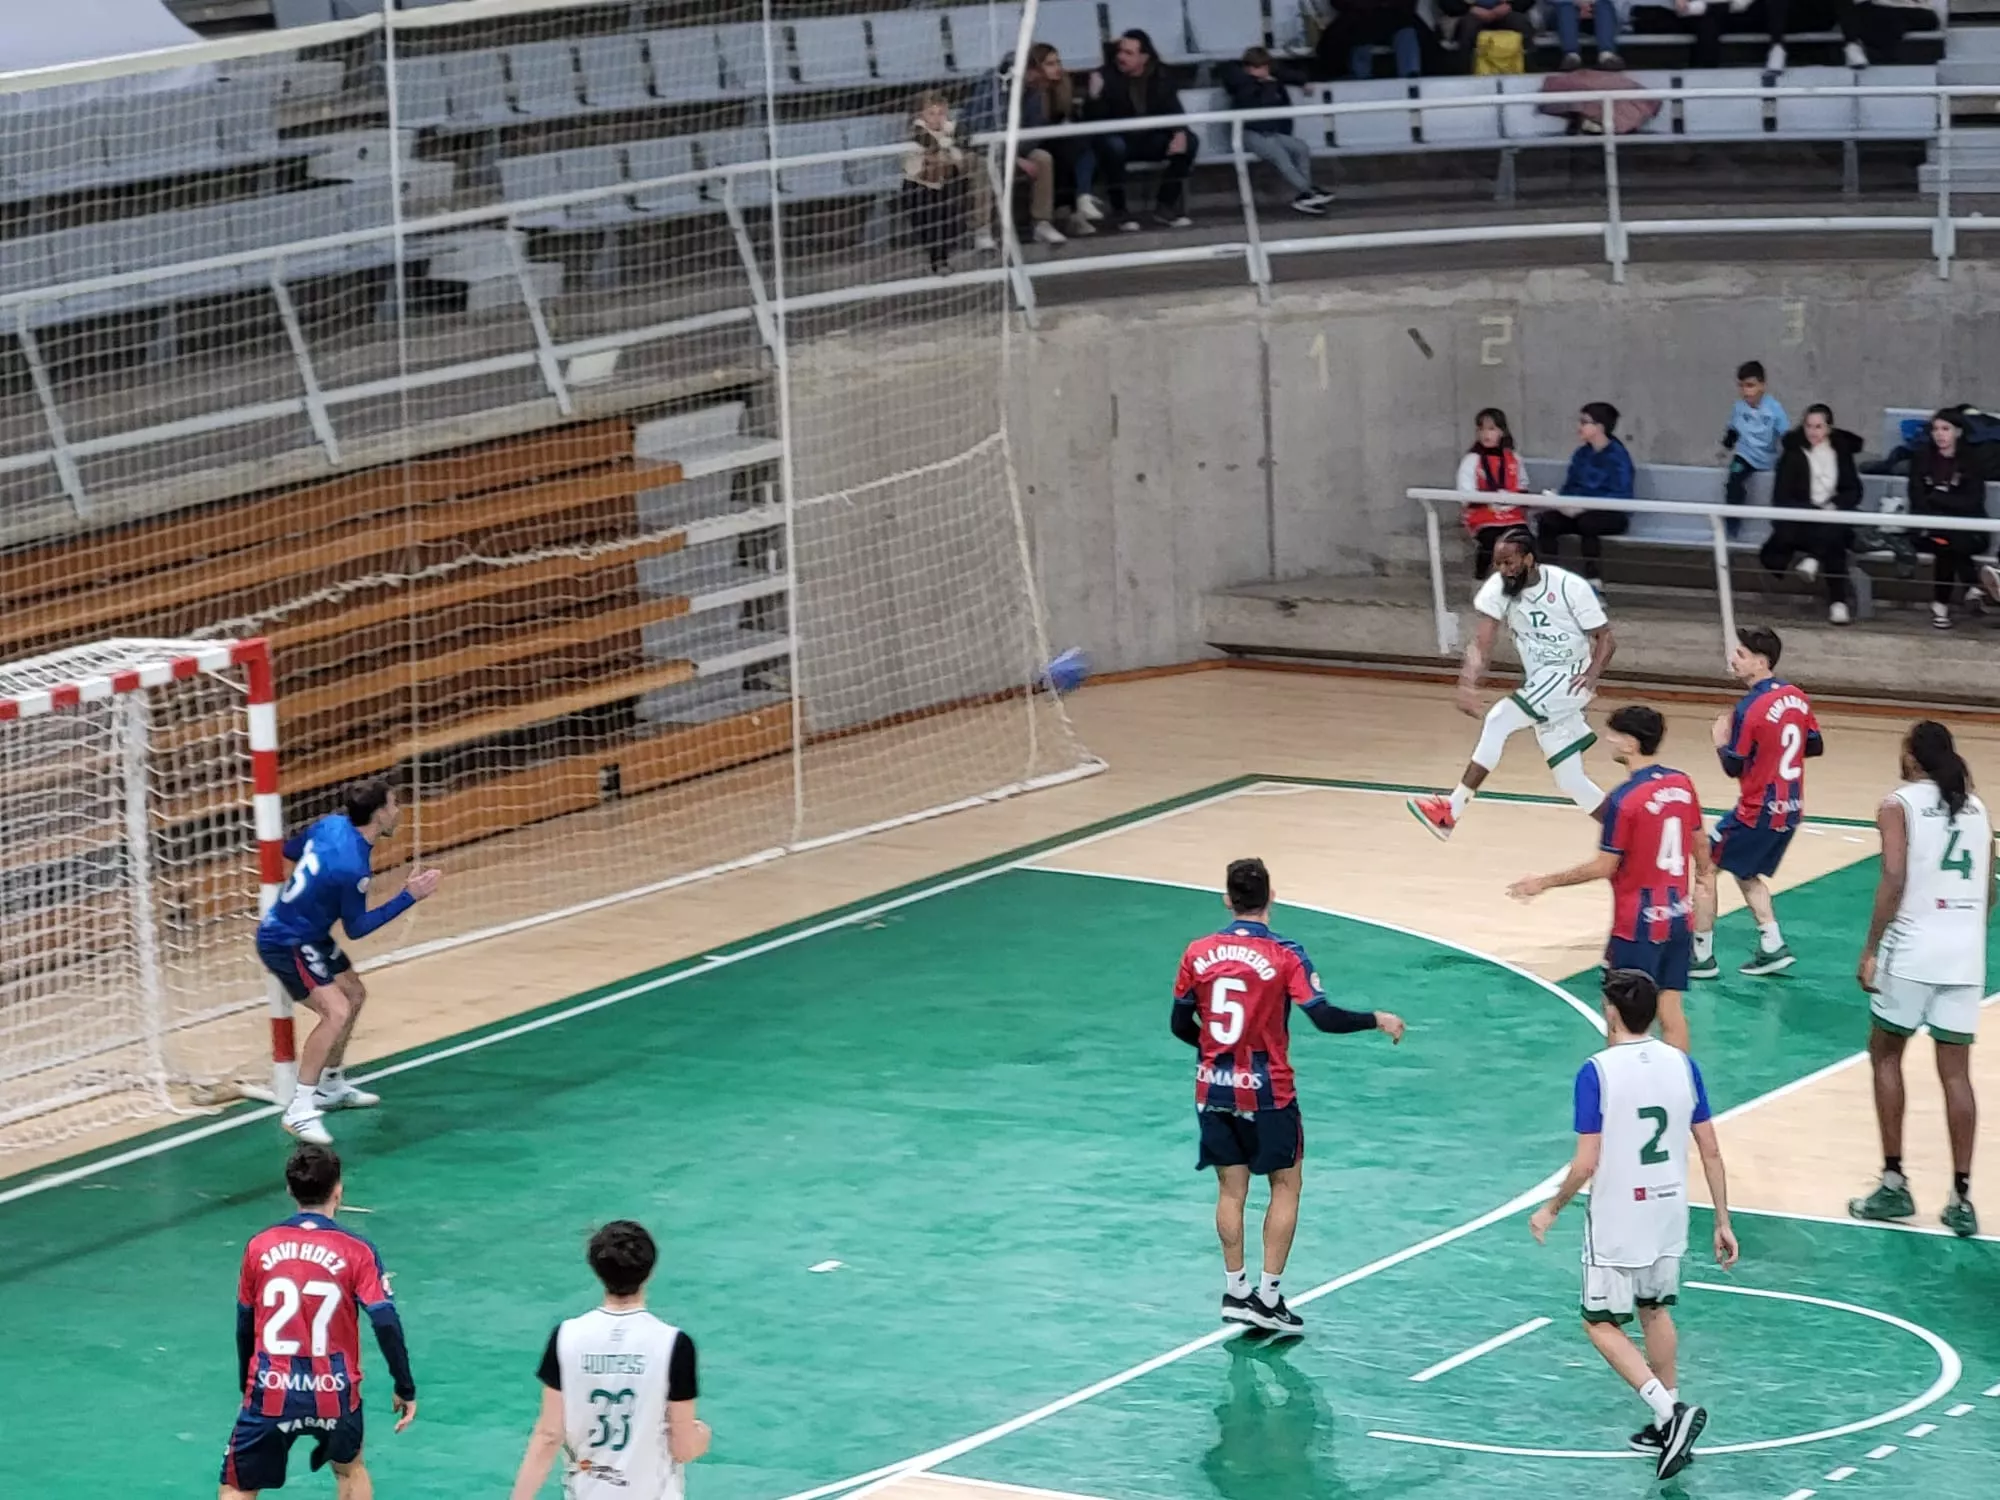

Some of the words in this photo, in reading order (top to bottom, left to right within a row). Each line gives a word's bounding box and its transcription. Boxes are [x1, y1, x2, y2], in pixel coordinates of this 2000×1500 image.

[1308, 332, 1328, 391] 1
[1479, 316, 1513, 365] 2
[1529, 610, 1551, 628] 12
[1778, 723, 1801, 781] 2
[1656, 816, 1685, 876] 4
[1941, 829, 1972, 880] 4
[1209, 976, 1247, 1045] 5
[1637, 1105, 1669, 1165] 2
[260, 1241, 298, 1271] JAVI
[299, 1243, 347, 1275] HDEZ
[263, 1277, 341, 1357] 27
[258, 1370, 345, 1392] SOMMOS
[588, 1388, 635, 1451] 33
